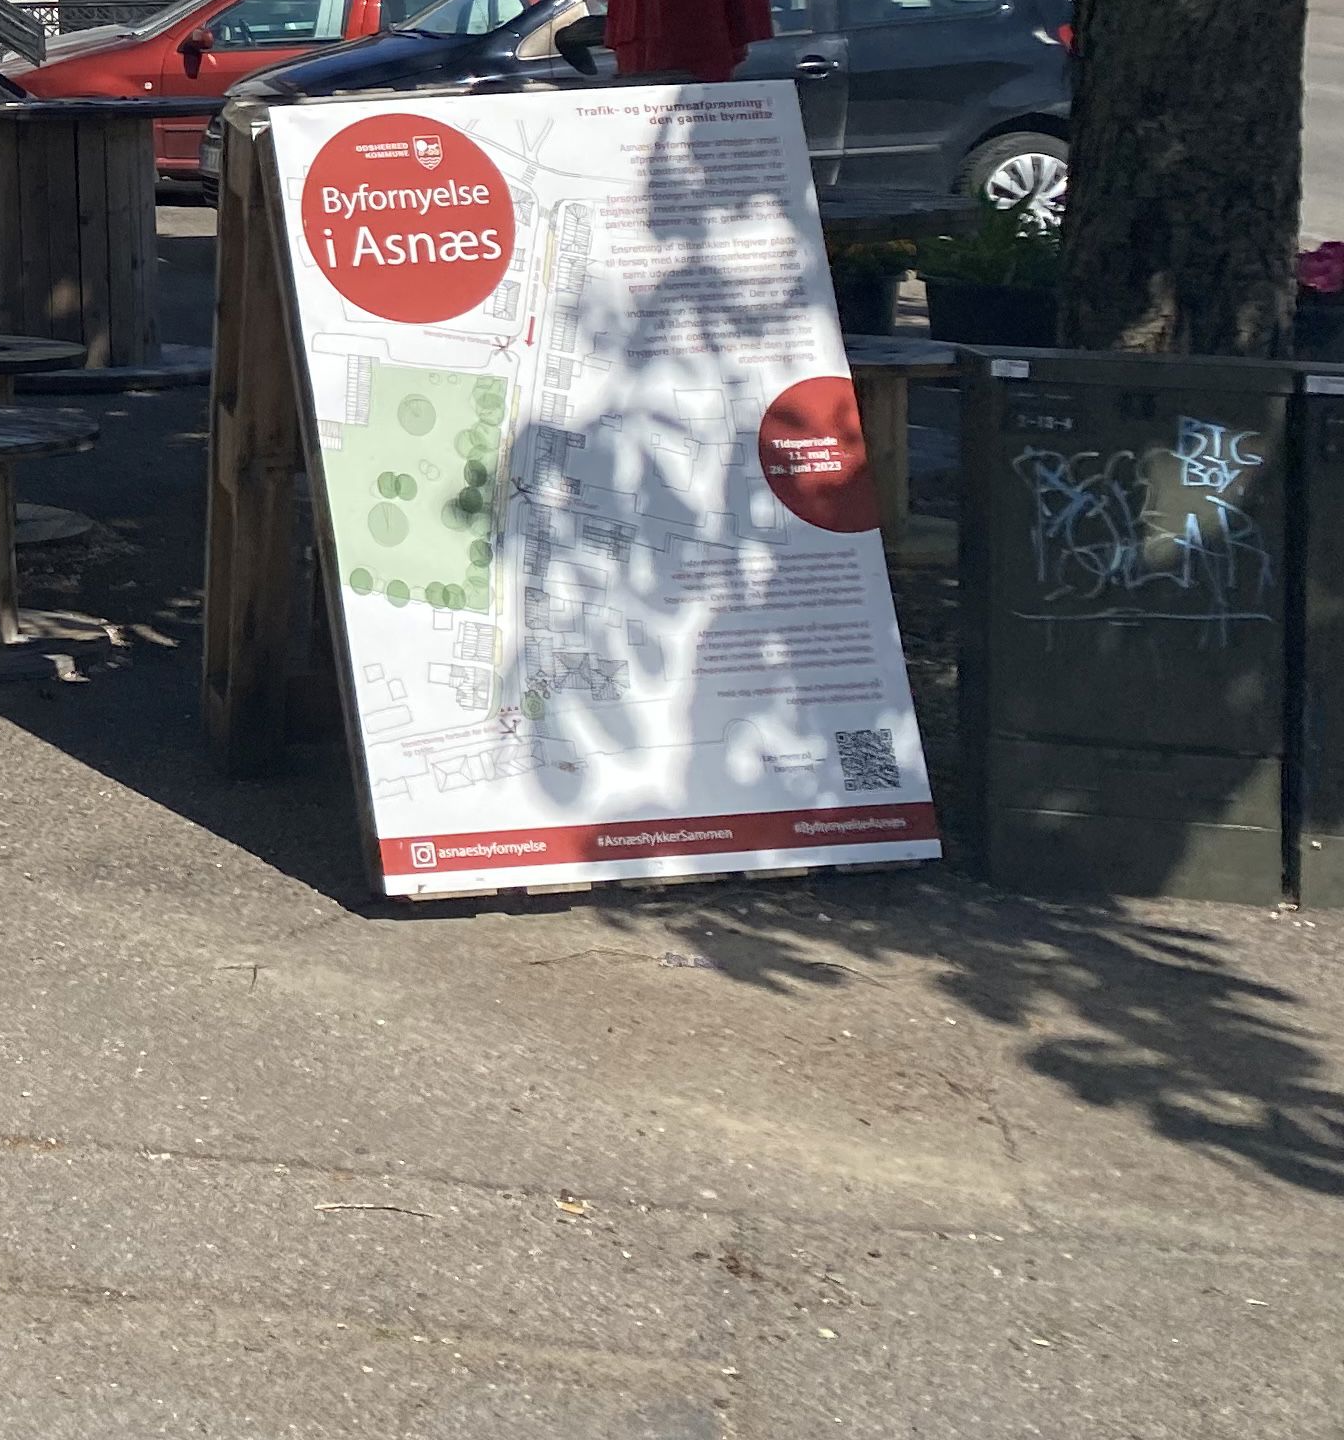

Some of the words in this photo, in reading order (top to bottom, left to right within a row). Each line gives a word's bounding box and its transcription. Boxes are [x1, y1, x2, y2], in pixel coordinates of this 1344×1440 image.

[576, 105, 621, 118] Trafik-
[624, 106, 641, 116] og
[649, 114, 673, 126] den
[678, 113, 717, 126] gamle
[365, 150, 410, 160] KOMMUNE
[322, 179, 490, 220] Byfornyelse
[323, 228, 338, 269] i
[352, 225, 502, 268] Asnæs
[772, 437, 838, 449] Tidsperiode
[808, 449, 830, 461] maj
[813, 462, 842, 471] 2023
[438, 839, 547, 860] asnaesbyfornyelse
